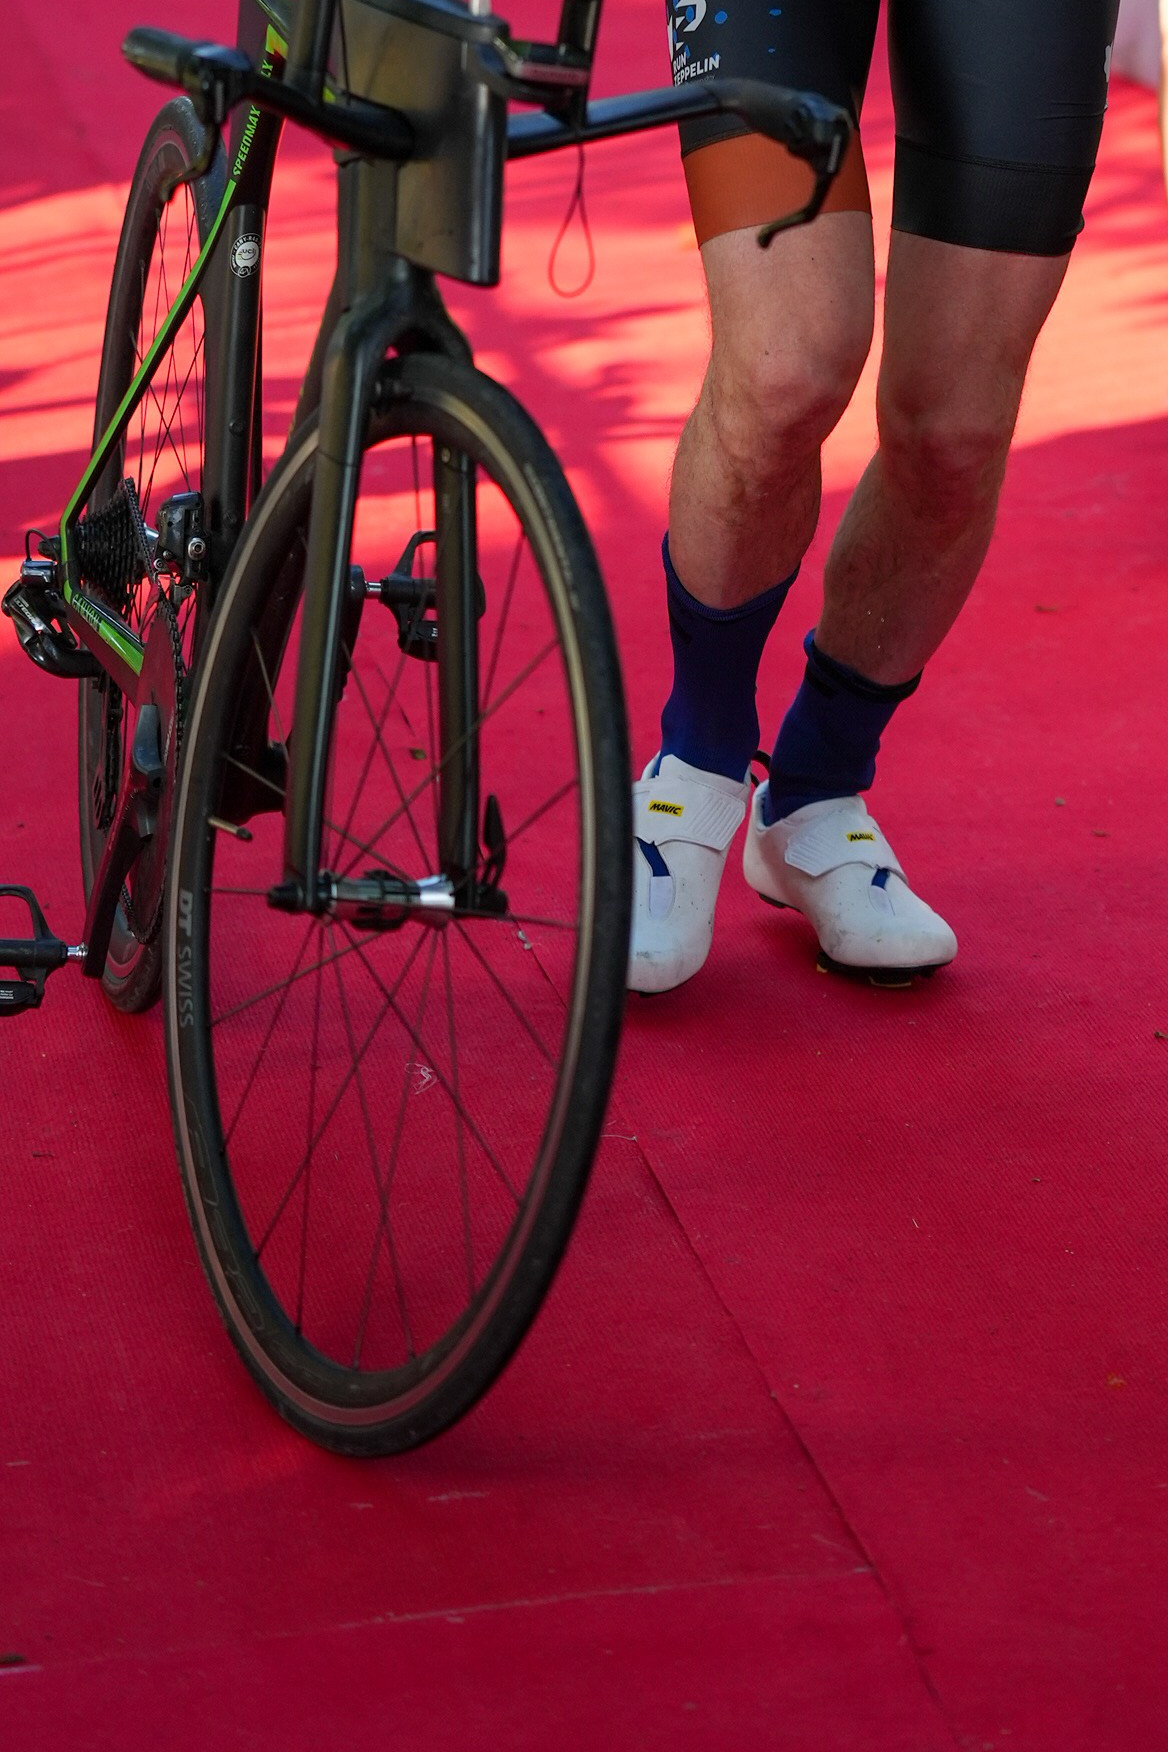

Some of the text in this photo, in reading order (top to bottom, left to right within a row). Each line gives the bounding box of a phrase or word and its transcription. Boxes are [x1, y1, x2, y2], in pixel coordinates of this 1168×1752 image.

[673, 51, 687, 76] RUN
[650, 800, 682, 816] MAVIC
[849, 832, 874, 842] MAVIC
[178, 888, 195, 1029] DT SWISS
